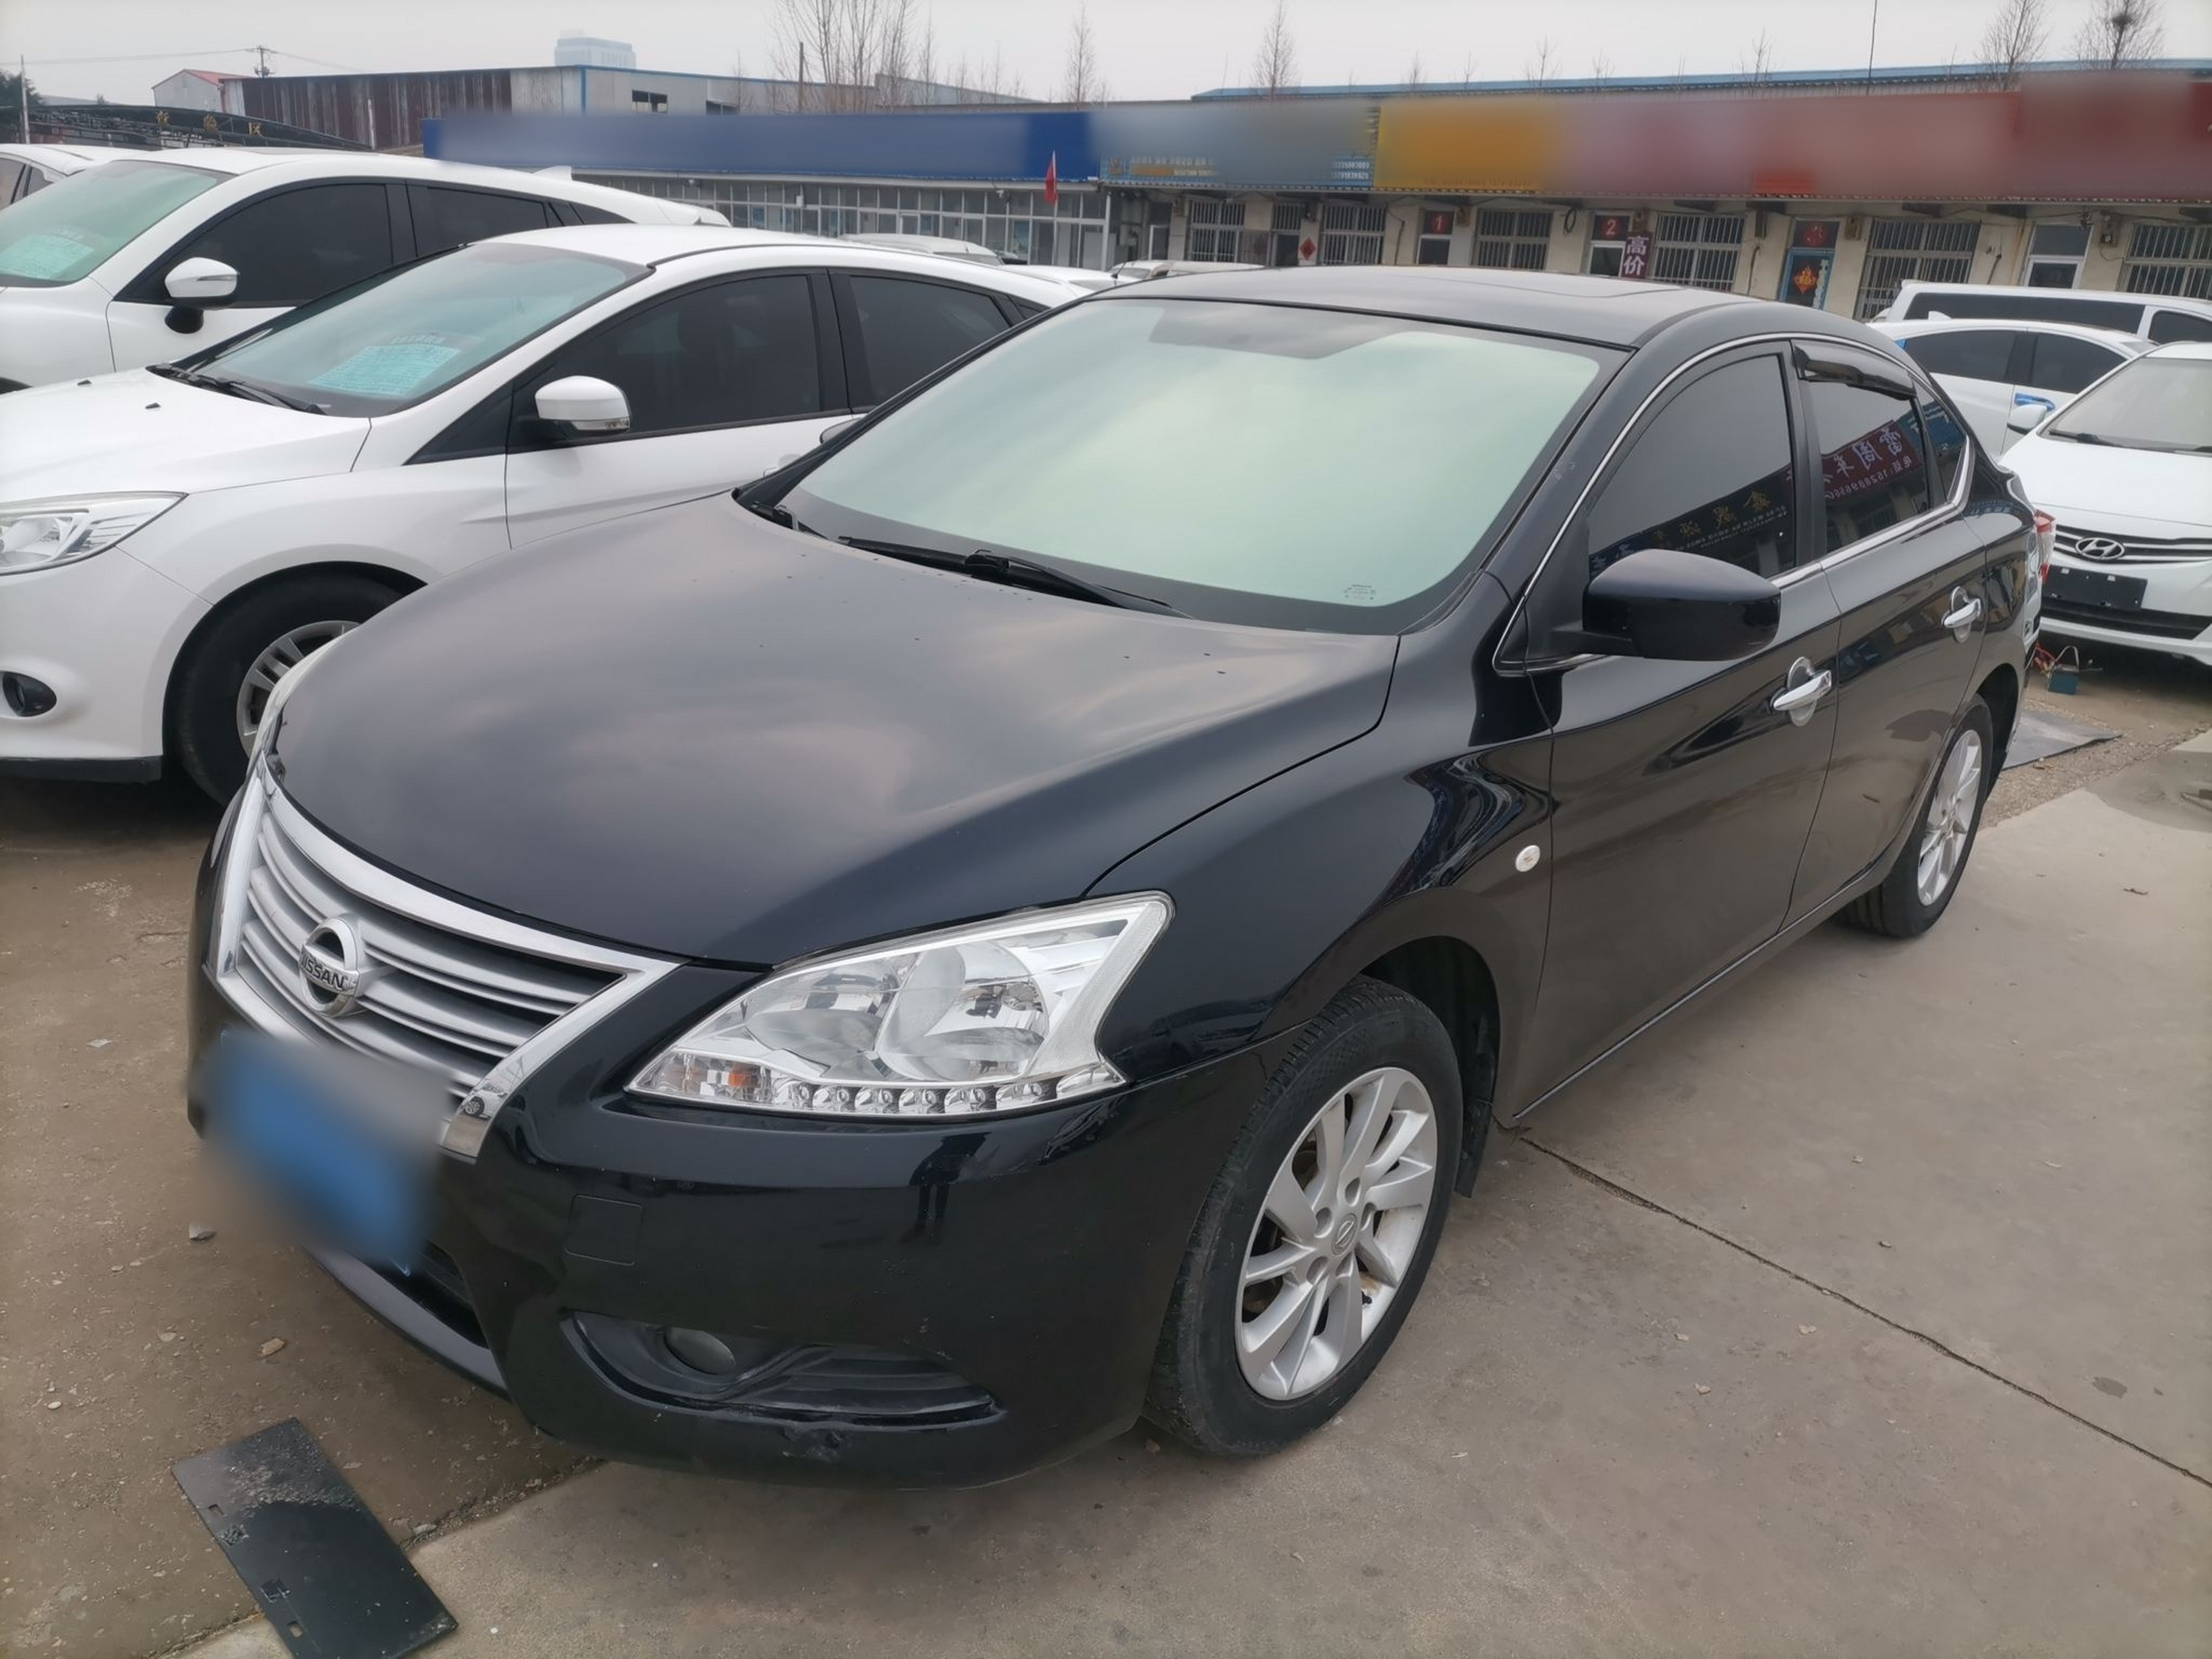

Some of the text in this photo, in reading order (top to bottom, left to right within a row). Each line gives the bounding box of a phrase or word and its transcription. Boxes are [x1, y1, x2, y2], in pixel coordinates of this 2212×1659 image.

[1605, 218, 1616, 236] 2
[1623, 235, 1649, 276] 高价
[301, 952, 346, 990] NISSAN
